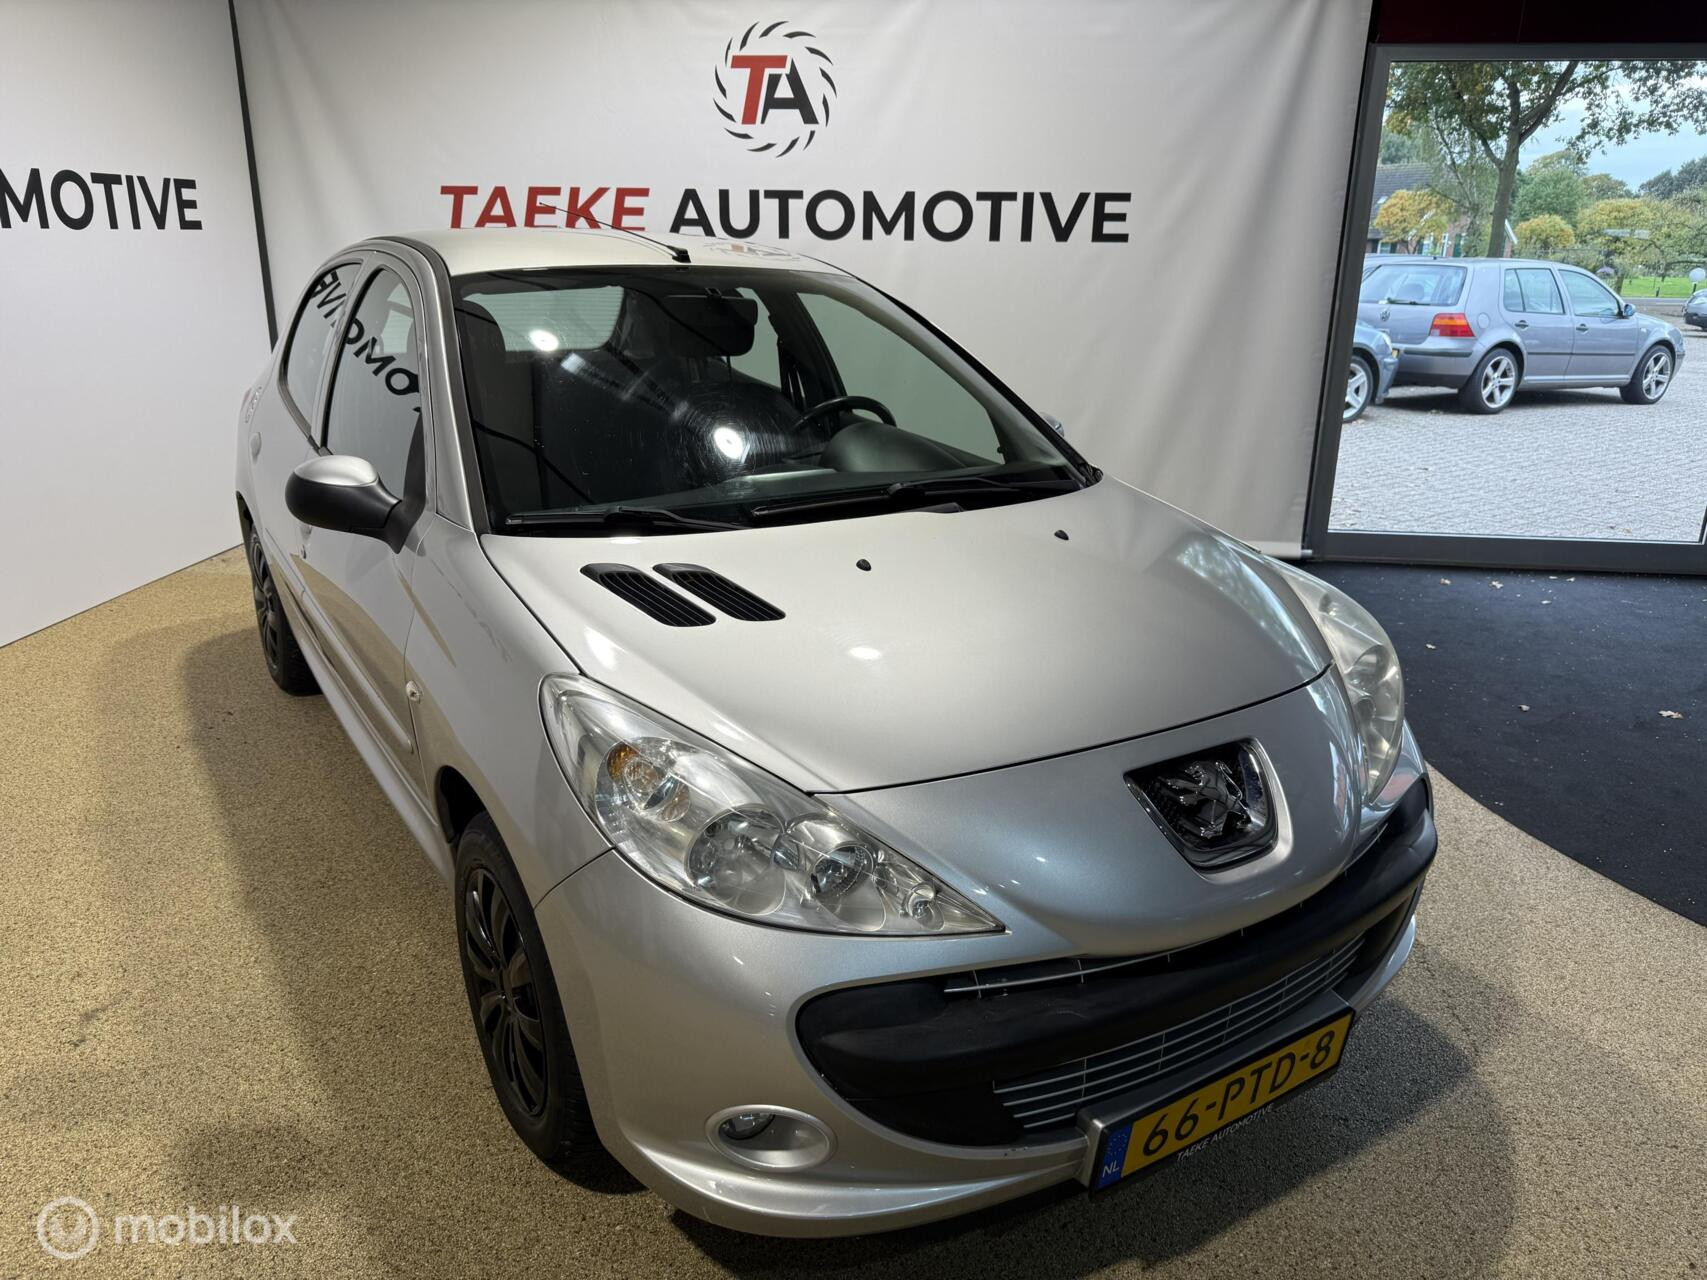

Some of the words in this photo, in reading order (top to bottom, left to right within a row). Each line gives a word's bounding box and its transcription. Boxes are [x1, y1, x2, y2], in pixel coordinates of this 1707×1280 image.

[730, 54, 820, 125] TA
[0, 167, 203, 231] MOTIVE
[440, 185, 651, 231] TAEKE
[669, 188, 1132, 243] AUTOMOTIVE
[1142, 1030, 1336, 1156] 66-PTD-8
[1177, 1137, 1212, 1161] TAEKE
[1210, 1103, 1275, 1144] AUTOMOTIVE
[1102, 1162, 1121, 1178] NL
